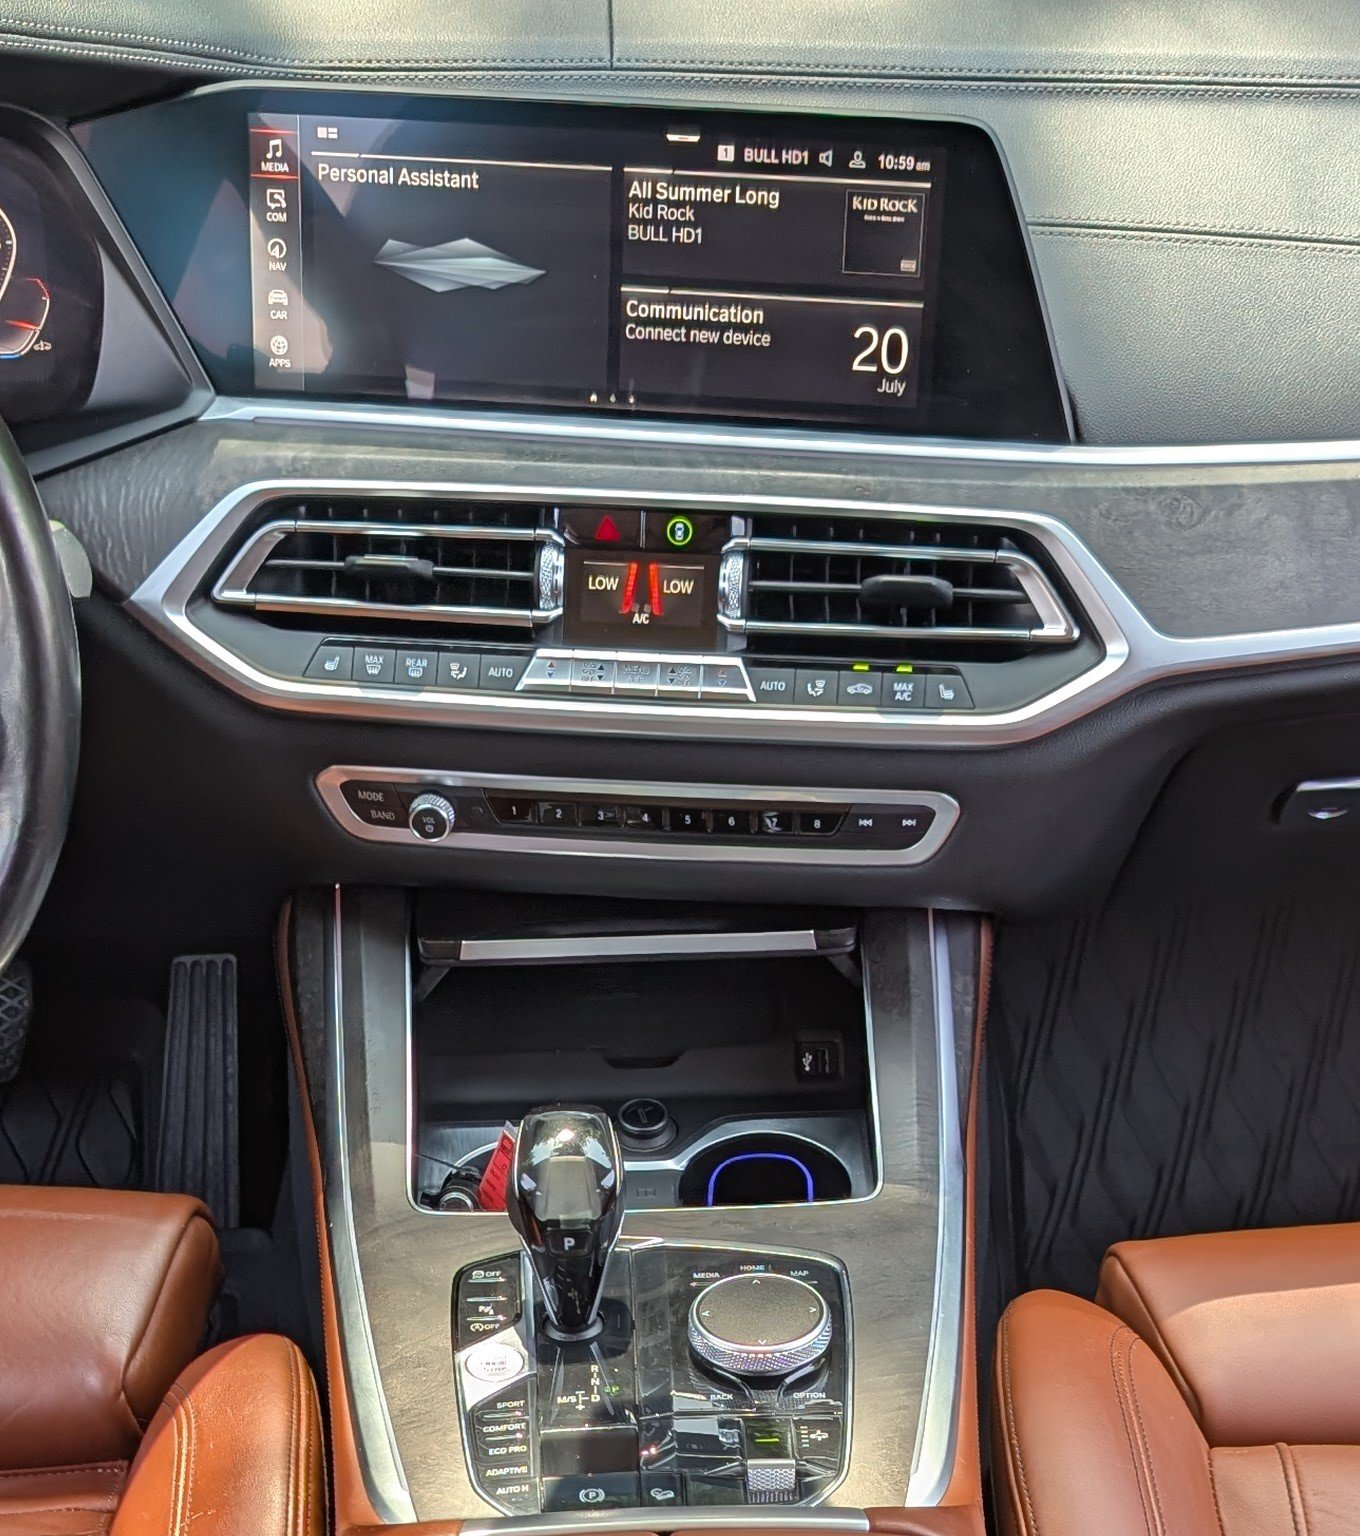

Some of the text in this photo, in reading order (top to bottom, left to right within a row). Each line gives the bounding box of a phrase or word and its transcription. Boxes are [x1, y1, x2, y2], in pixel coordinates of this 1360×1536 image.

[744, 148, 809, 165] BULL HD1
[261, 161, 289, 173] MEDIA
[877, 154, 931, 171] 10:59 am
[318, 163, 479, 189] Personal Assistant
[628, 181, 780, 209] All Summer Long
[266, 212, 287, 222] COM
[628, 203, 695, 221] Kid Rock
[627, 225, 703, 244] BULL HD1
[269, 262, 286, 271] NAV
[270, 310, 288, 320] CAR
[626, 300, 764, 324] Communication
[625, 324, 771, 347] Connect new device
[851, 326, 908, 374] 20
[269, 358, 291, 368] APPS
[877, 378, 906, 397] July
[588, 576, 619, 591] LOW
[663, 579, 694, 594] LOW
[632, 613, 650, 624] A/C
[365, 655, 384, 664] MAX
[406, 658, 428, 668] REAR
[488, 667, 513, 678] AUTO
[760, 681, 786, 691] AUTO
[893, 682, 913, 692] MAX
[895, 691, 912, 701] A/C
[358, 790, 384, 802] MODE
[371, 810, 395, 821] BAND
[511, 805, 517, 816] 1
[555, 809, 563, 819] 2
[597, 811, 604, 821] 3
[642, 813, 649, 822] 4
[685, 815, 691, 825] 5
[728, 816, 735, 827] 6
[814, 819, 821, 829] 8
[564, 1237, 575, 1250] P
[591, 1365, 599, 1373] R
[497, 1400, 525, 1409] SPORT
[557, 1396, 577, 1404] M/S
[483, 1422, 527, 1433] COMFORT
[488, 1445, 527, 1456] ECO PRO
[496, 1484, 529, 1495] AUTO H
